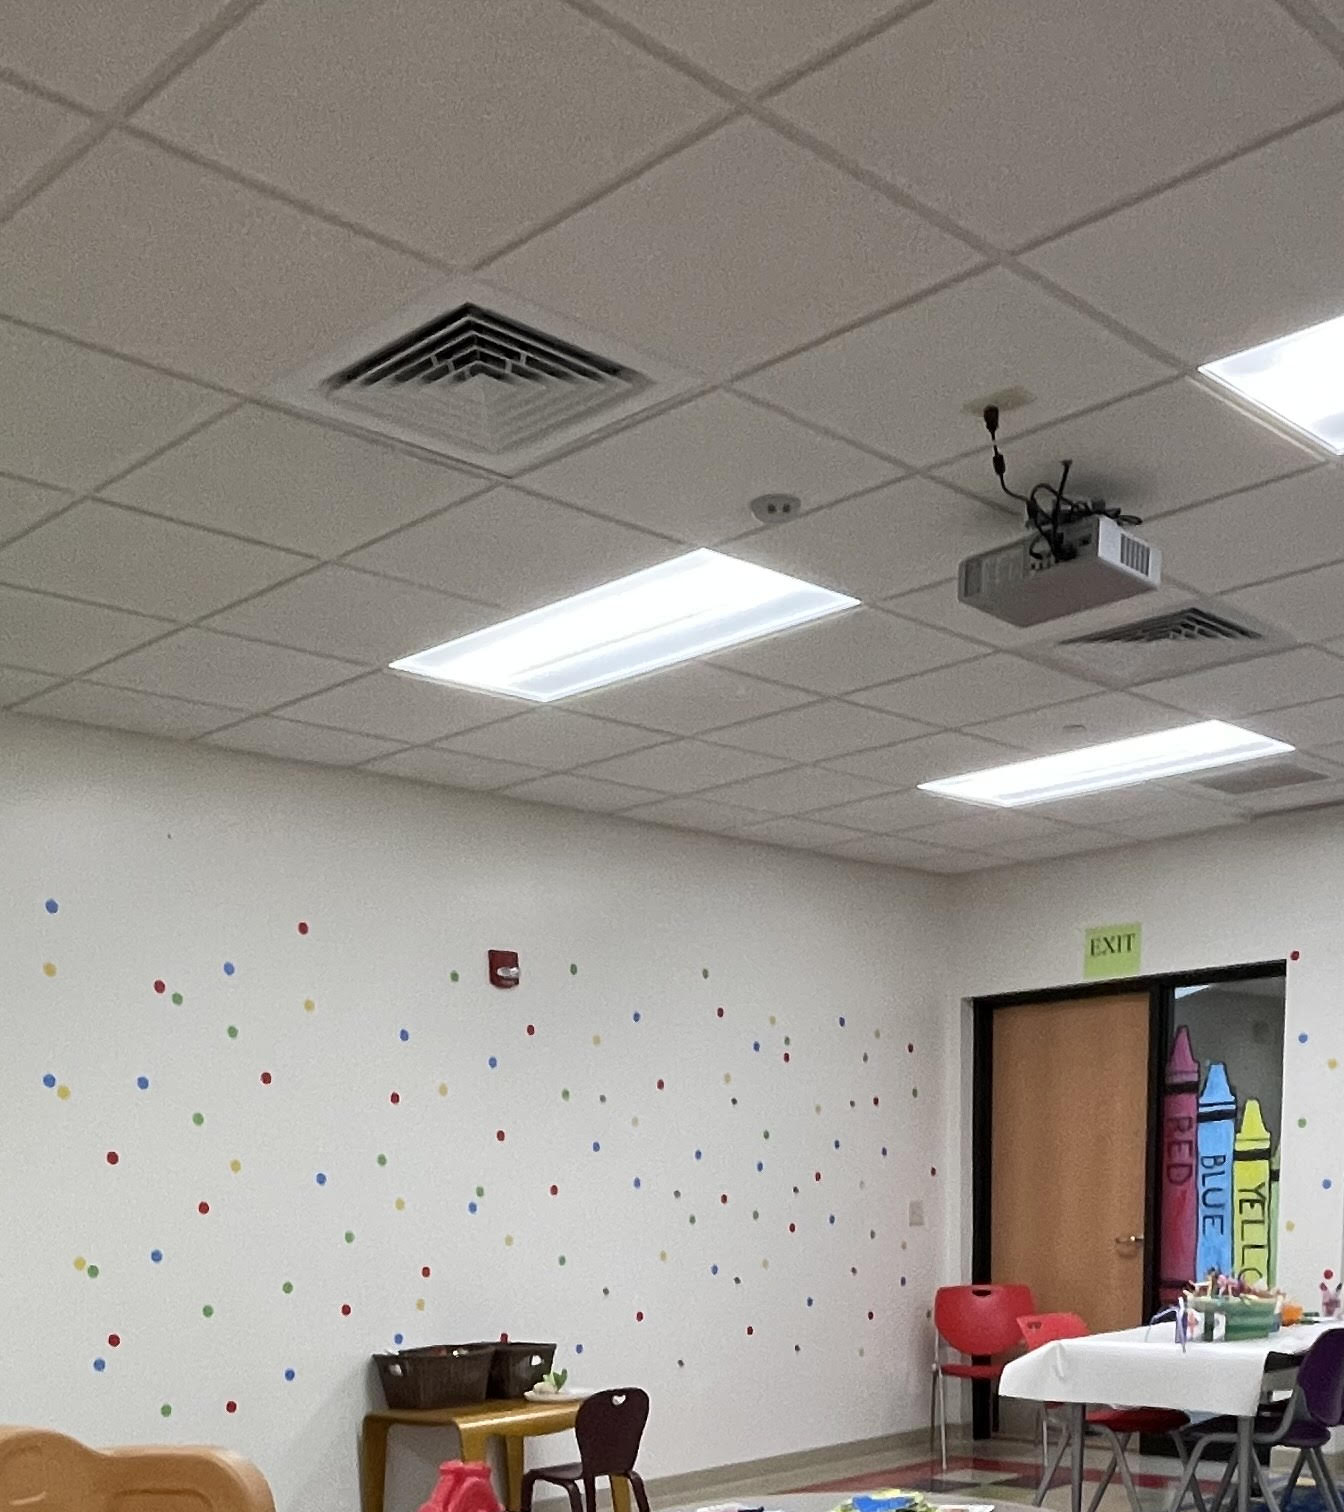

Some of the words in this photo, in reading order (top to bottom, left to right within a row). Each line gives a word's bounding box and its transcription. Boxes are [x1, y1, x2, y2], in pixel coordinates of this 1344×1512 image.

[1090, 933, 1136, 956] EXIT
[1166, 1116, 1194, 1186] RED
[1200, 1154, 1227, 1237] BLUE
